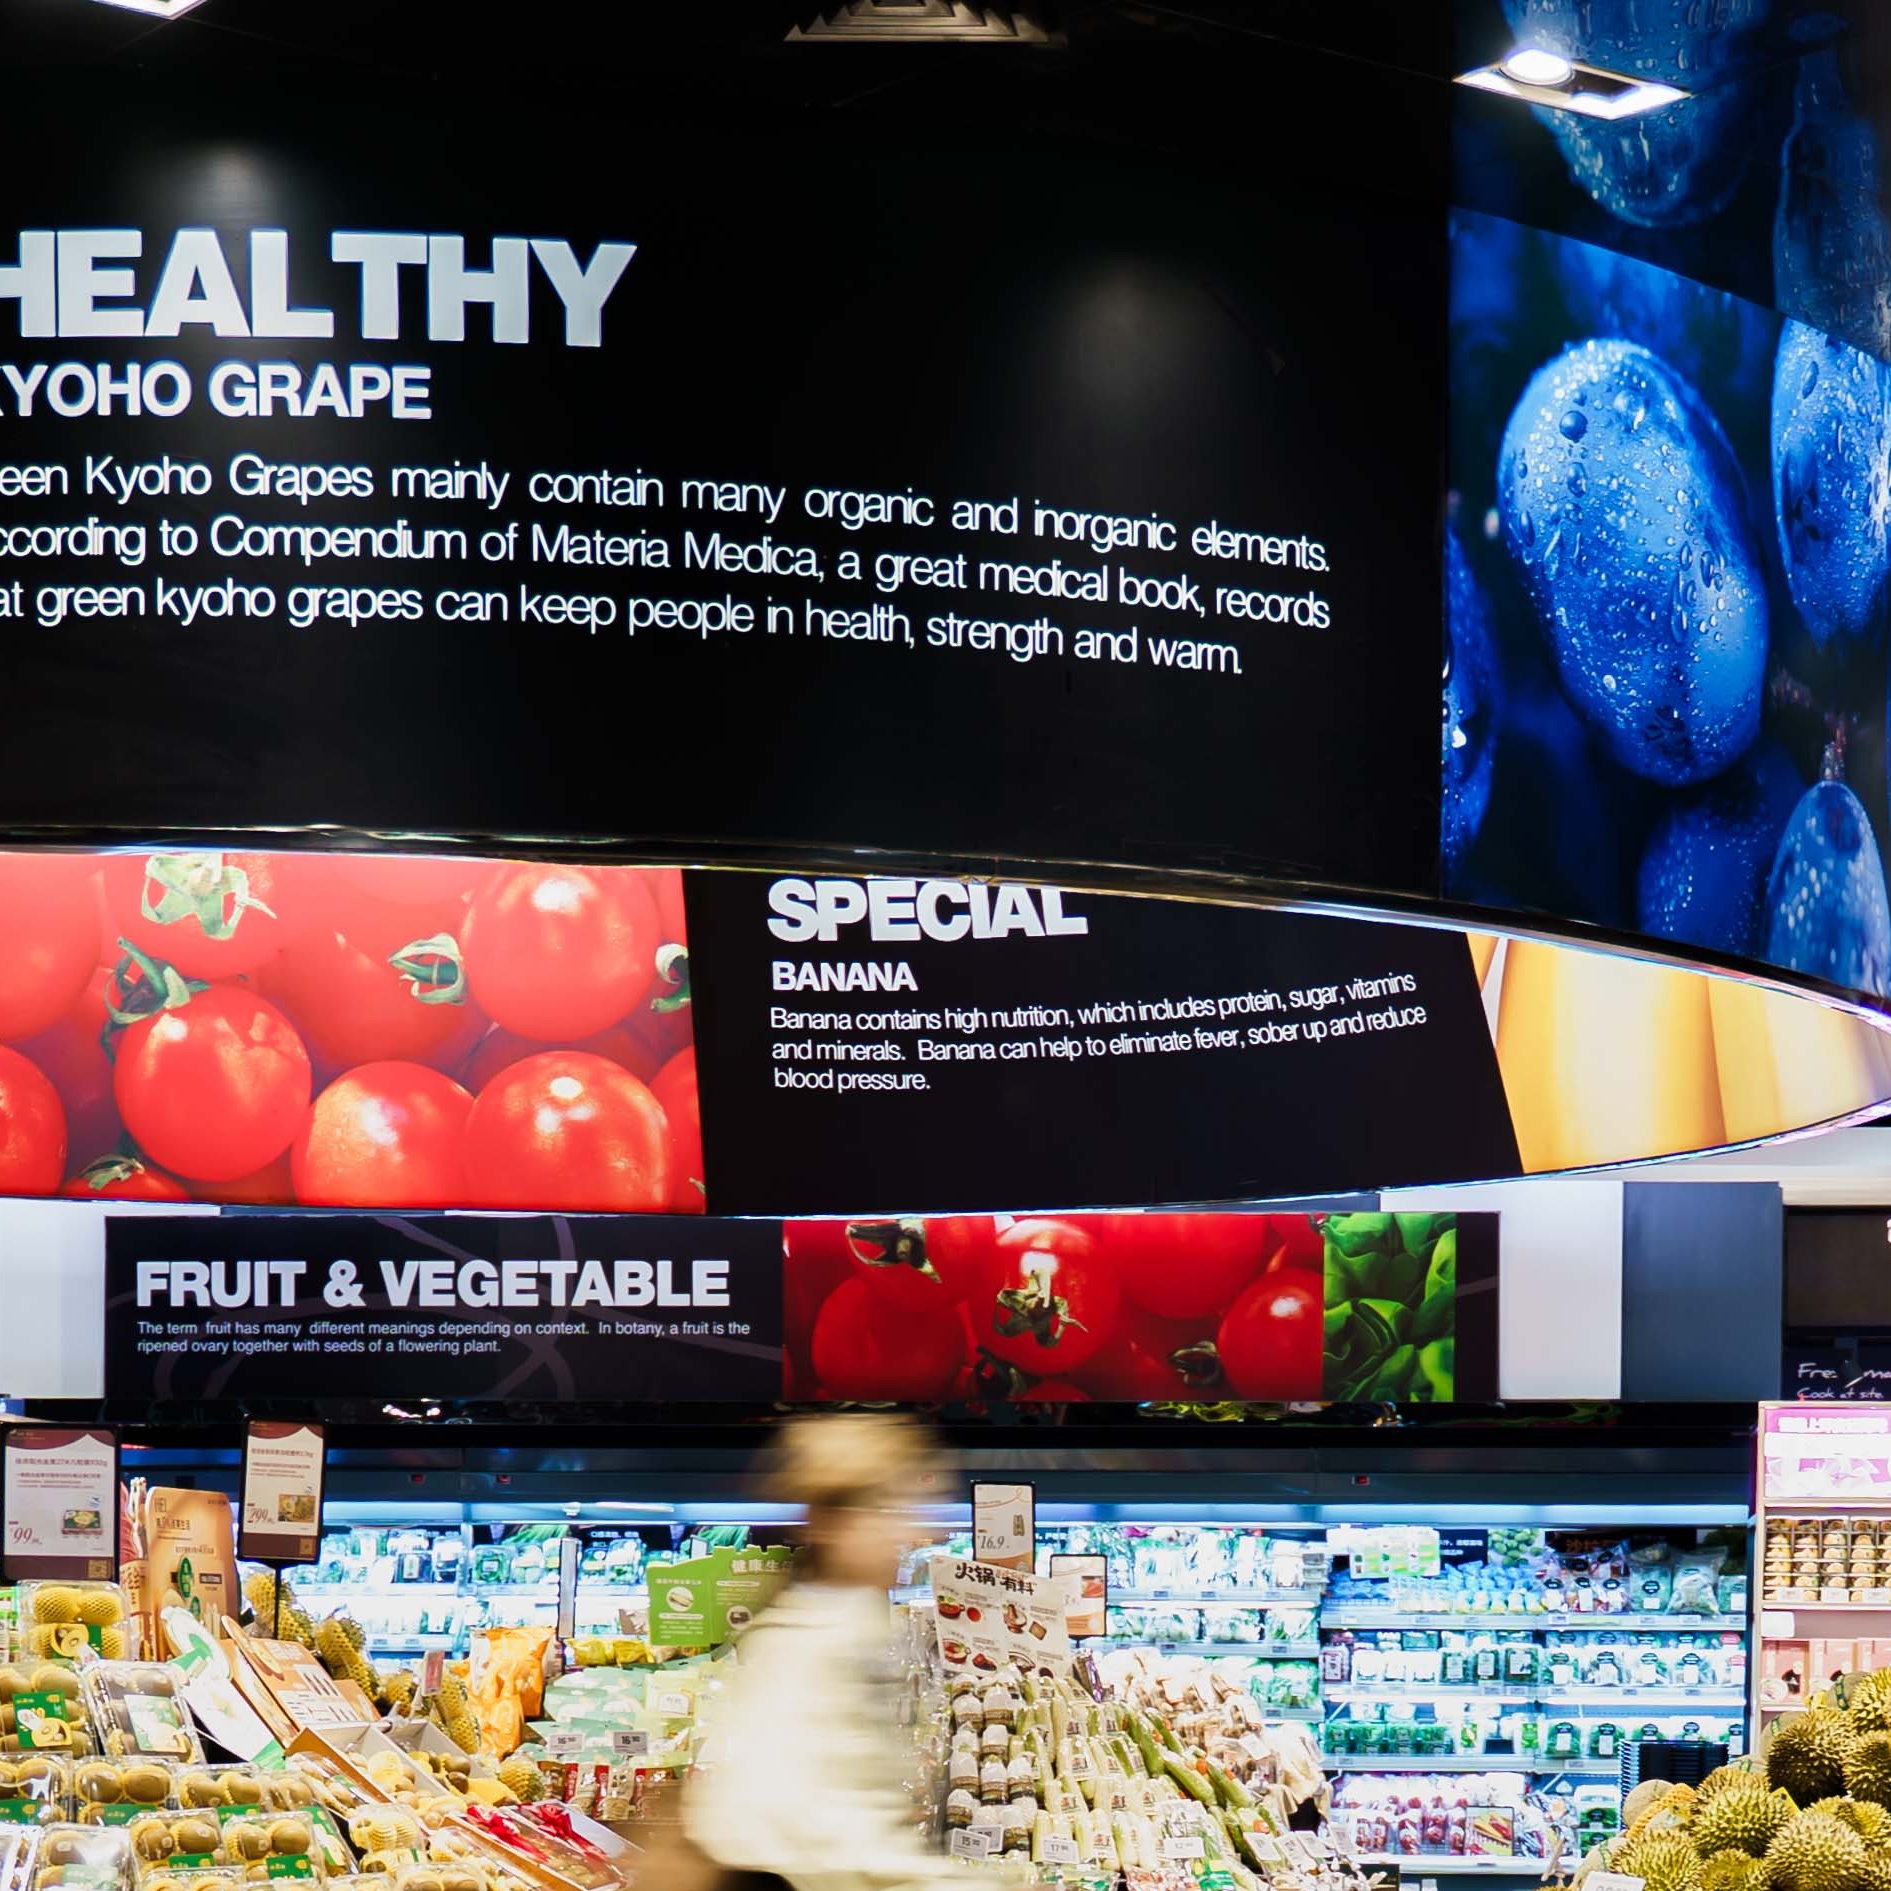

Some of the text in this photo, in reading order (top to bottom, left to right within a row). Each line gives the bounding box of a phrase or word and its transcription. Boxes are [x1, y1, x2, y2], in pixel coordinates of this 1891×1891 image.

[209, 361, 431, 419] GRAPE
[85, 455, 213, 505] Kyoho
[229, 453, 375, 506] Grapes
[391, 460, 510, 510] mainly
[528, 468, 664, 507] contain
[681, 480, 787, 524] many
[804, 487, 935, 531] organic
[951, 496, 1019, 534] and
[1034, 499, 1177, 554] inorganic
[1191, 519, 1330, 572] elements.
[158, 519, 199, 557] to
[210, 514, 467, 567] Compendium
[480, 522, 519, 562] of
[532, 523, 671, 568] Materia
[684, 530, 825, 583] Medica,
[837, 550, 862, 580] a
[875, 553, 968, 593] great
[979, 559, 1109, 602] medical
[1119, 566, 1206, 618] book,
[1216, 587, 1331, 629] records
[36, 586, 146, 627] green
[156, 576, 276, 627] kyoho
[287, 587, 424, 628] grapes
[435, 590, 509, 622] can
[520, 583, 617, 635] keep
[628, 593, 755, 640] people
[767, 596, 794, 635] in
[805, 598, 915, 649] health,
[926, 612, 1064, 663] strength
[1073, 626, 1138, 663] and
[1147, 637, 1243, 675] warm.
[768, 880, 1089, 942] SPECIAL
[770, 971, 1417, 1035] Banana contains high nutrition, which includes protein, sugar, vitamins
[773, 962, 918, 991] BANANA
[771, 1005, 1427, 1062] and minerals. Banana can help to eliminate fever, sober up and reduce
[774, 1067, 931, 1094] blood pressure.
[137, 1260, 729, 1307] FRUIT & VEGETABLE
[137, 1321, 750, 1338] The term fruit has many different meanings depending on context. In botany, a fruit is the
[137, 1339, 502, 1355] ripened ovary together with seeds of a flowering plant.
